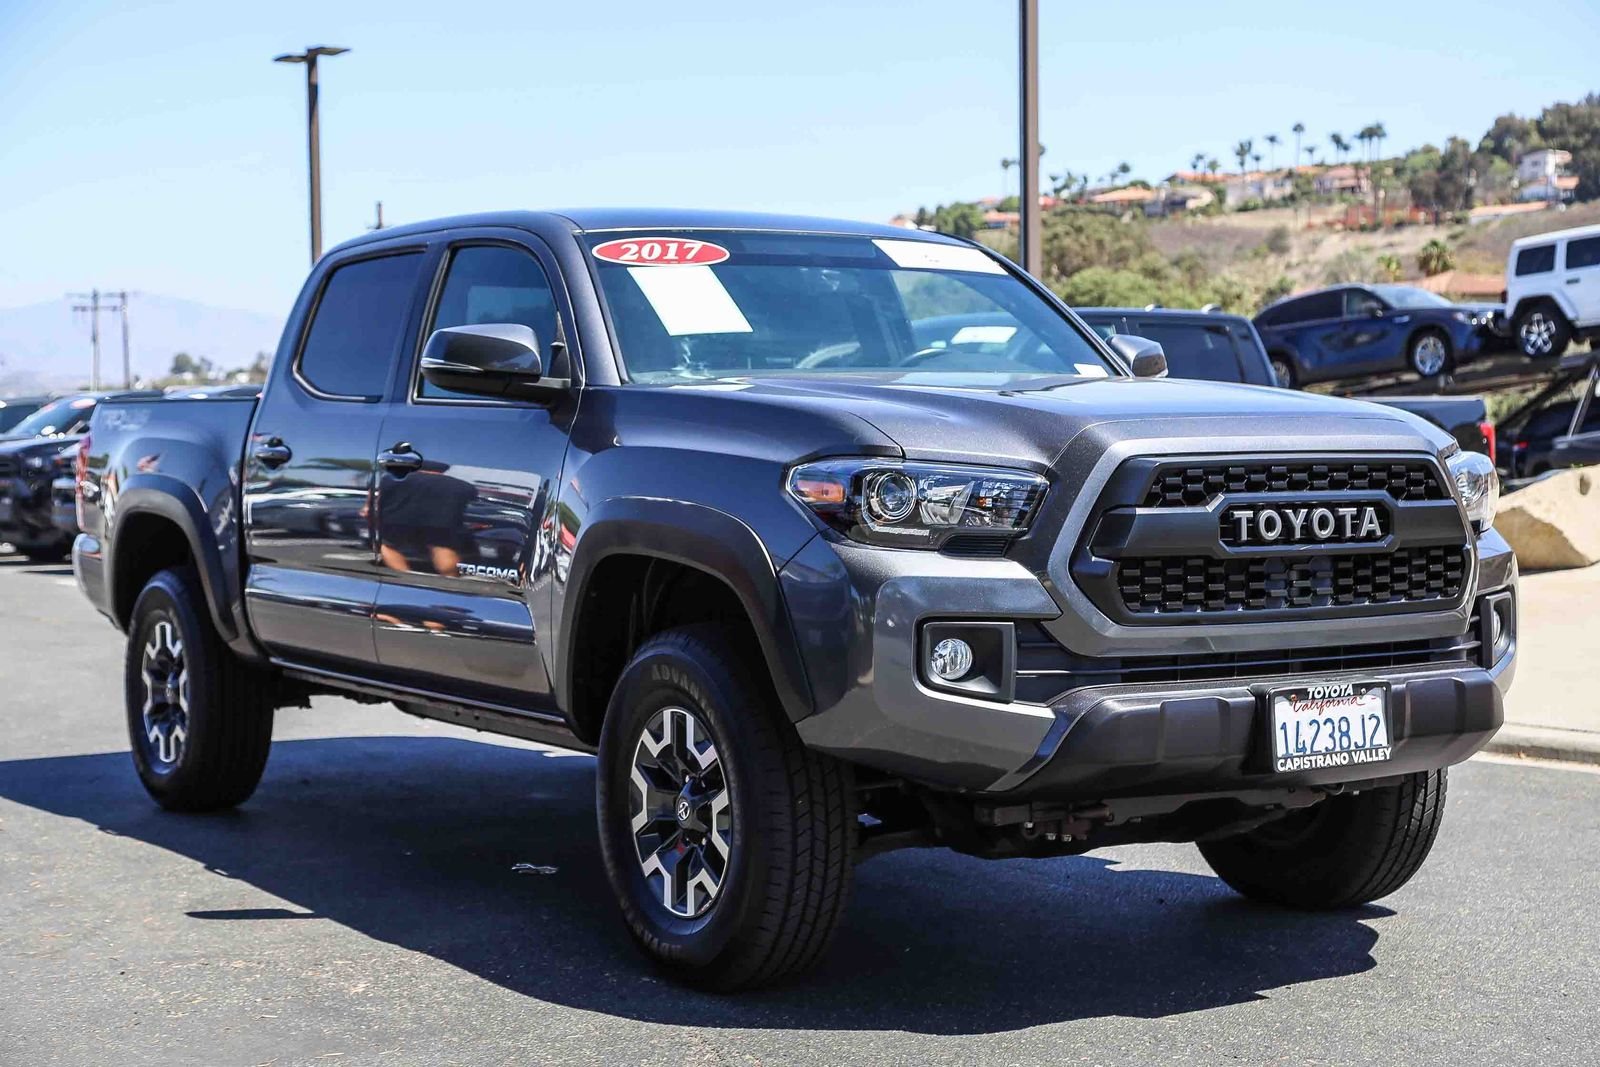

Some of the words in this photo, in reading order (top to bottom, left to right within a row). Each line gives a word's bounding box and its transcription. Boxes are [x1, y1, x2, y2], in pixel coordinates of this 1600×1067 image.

[619, 242, 703, 260] 2017
[1231, 507, 1382, 541] TOYOTA
[456, 563, 519, 582] TACOMA
[1307, 684, 1354, 699] TOYOTA
[1293, 695, 1365, 715] California
[1280, 714, 1382, 757] 14238J2
[1277, 752, 1349, 772] CAPISTRANO
[1352, 747, 1392, 763] VALLEY
